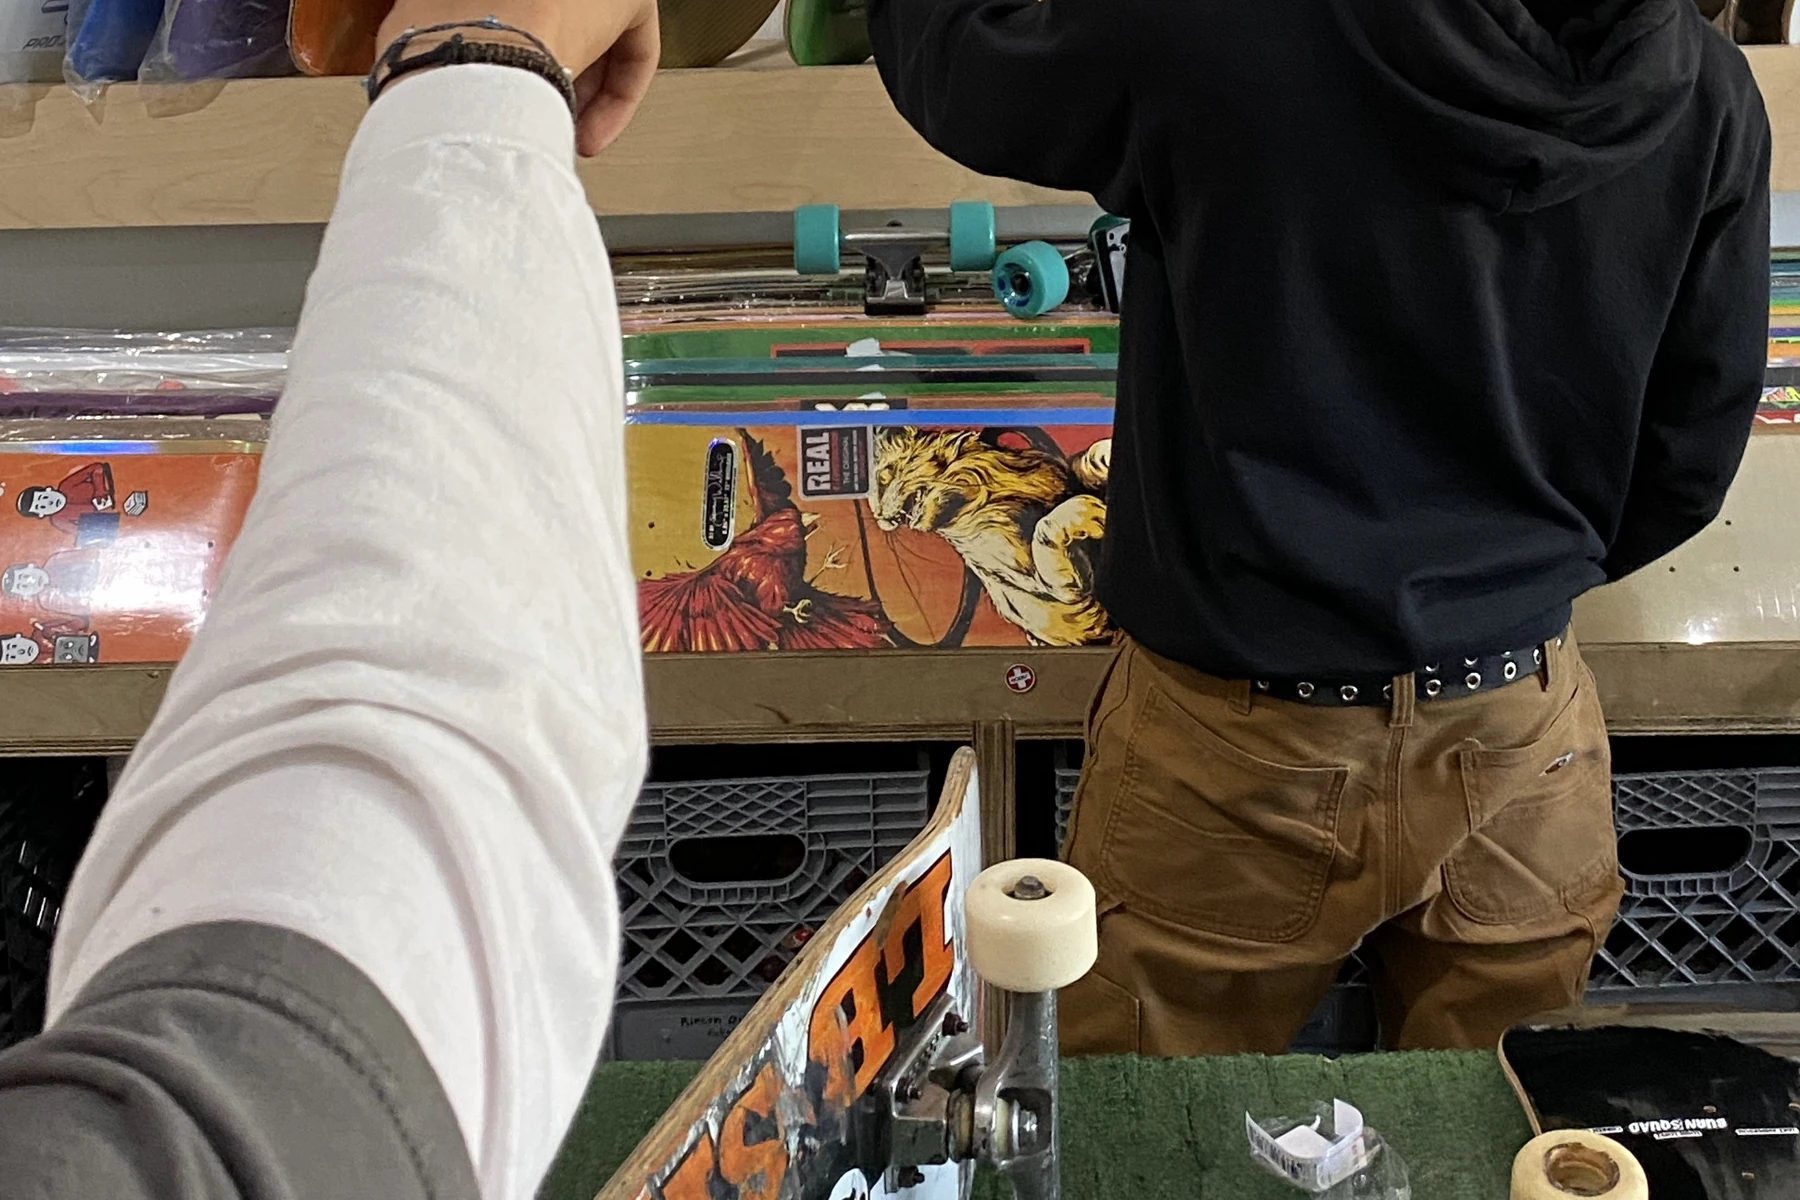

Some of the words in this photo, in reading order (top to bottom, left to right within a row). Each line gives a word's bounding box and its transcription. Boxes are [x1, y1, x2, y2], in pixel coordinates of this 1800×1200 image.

[805, 432, 831, 491] REAL
[841, 435, 851, 470] ORIGINAL
[1627, 1118, 1683, 1135] SQUAD
[1684, 1117, 1728, 1131] BURN
